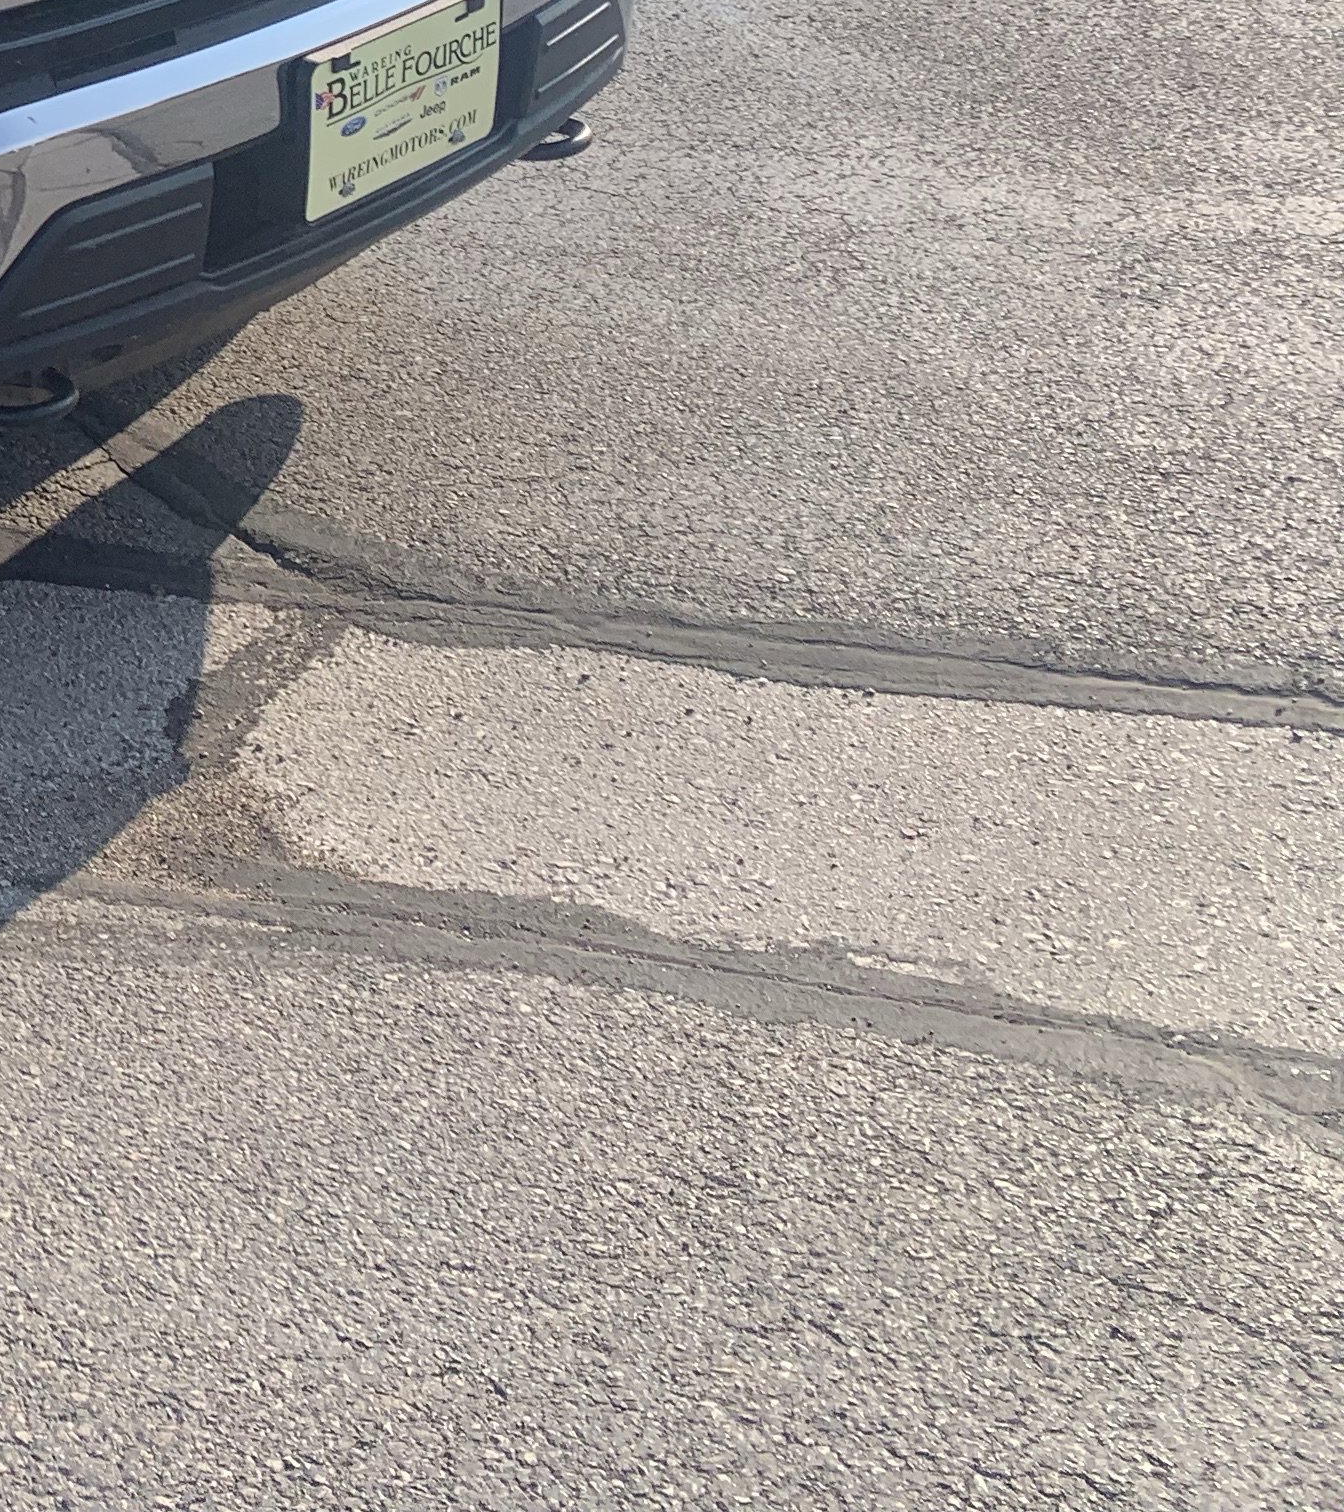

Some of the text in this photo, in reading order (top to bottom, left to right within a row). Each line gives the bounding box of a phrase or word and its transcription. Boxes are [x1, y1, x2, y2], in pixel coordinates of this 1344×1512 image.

[326, 65, 396, 121] BELLE
[401, 21, 497, 83] FOURCHE
[348, 44, 412, 83] WAREING
[450, 66, 481, 87] RAM
[420, 100, 447, 119] Jeep
